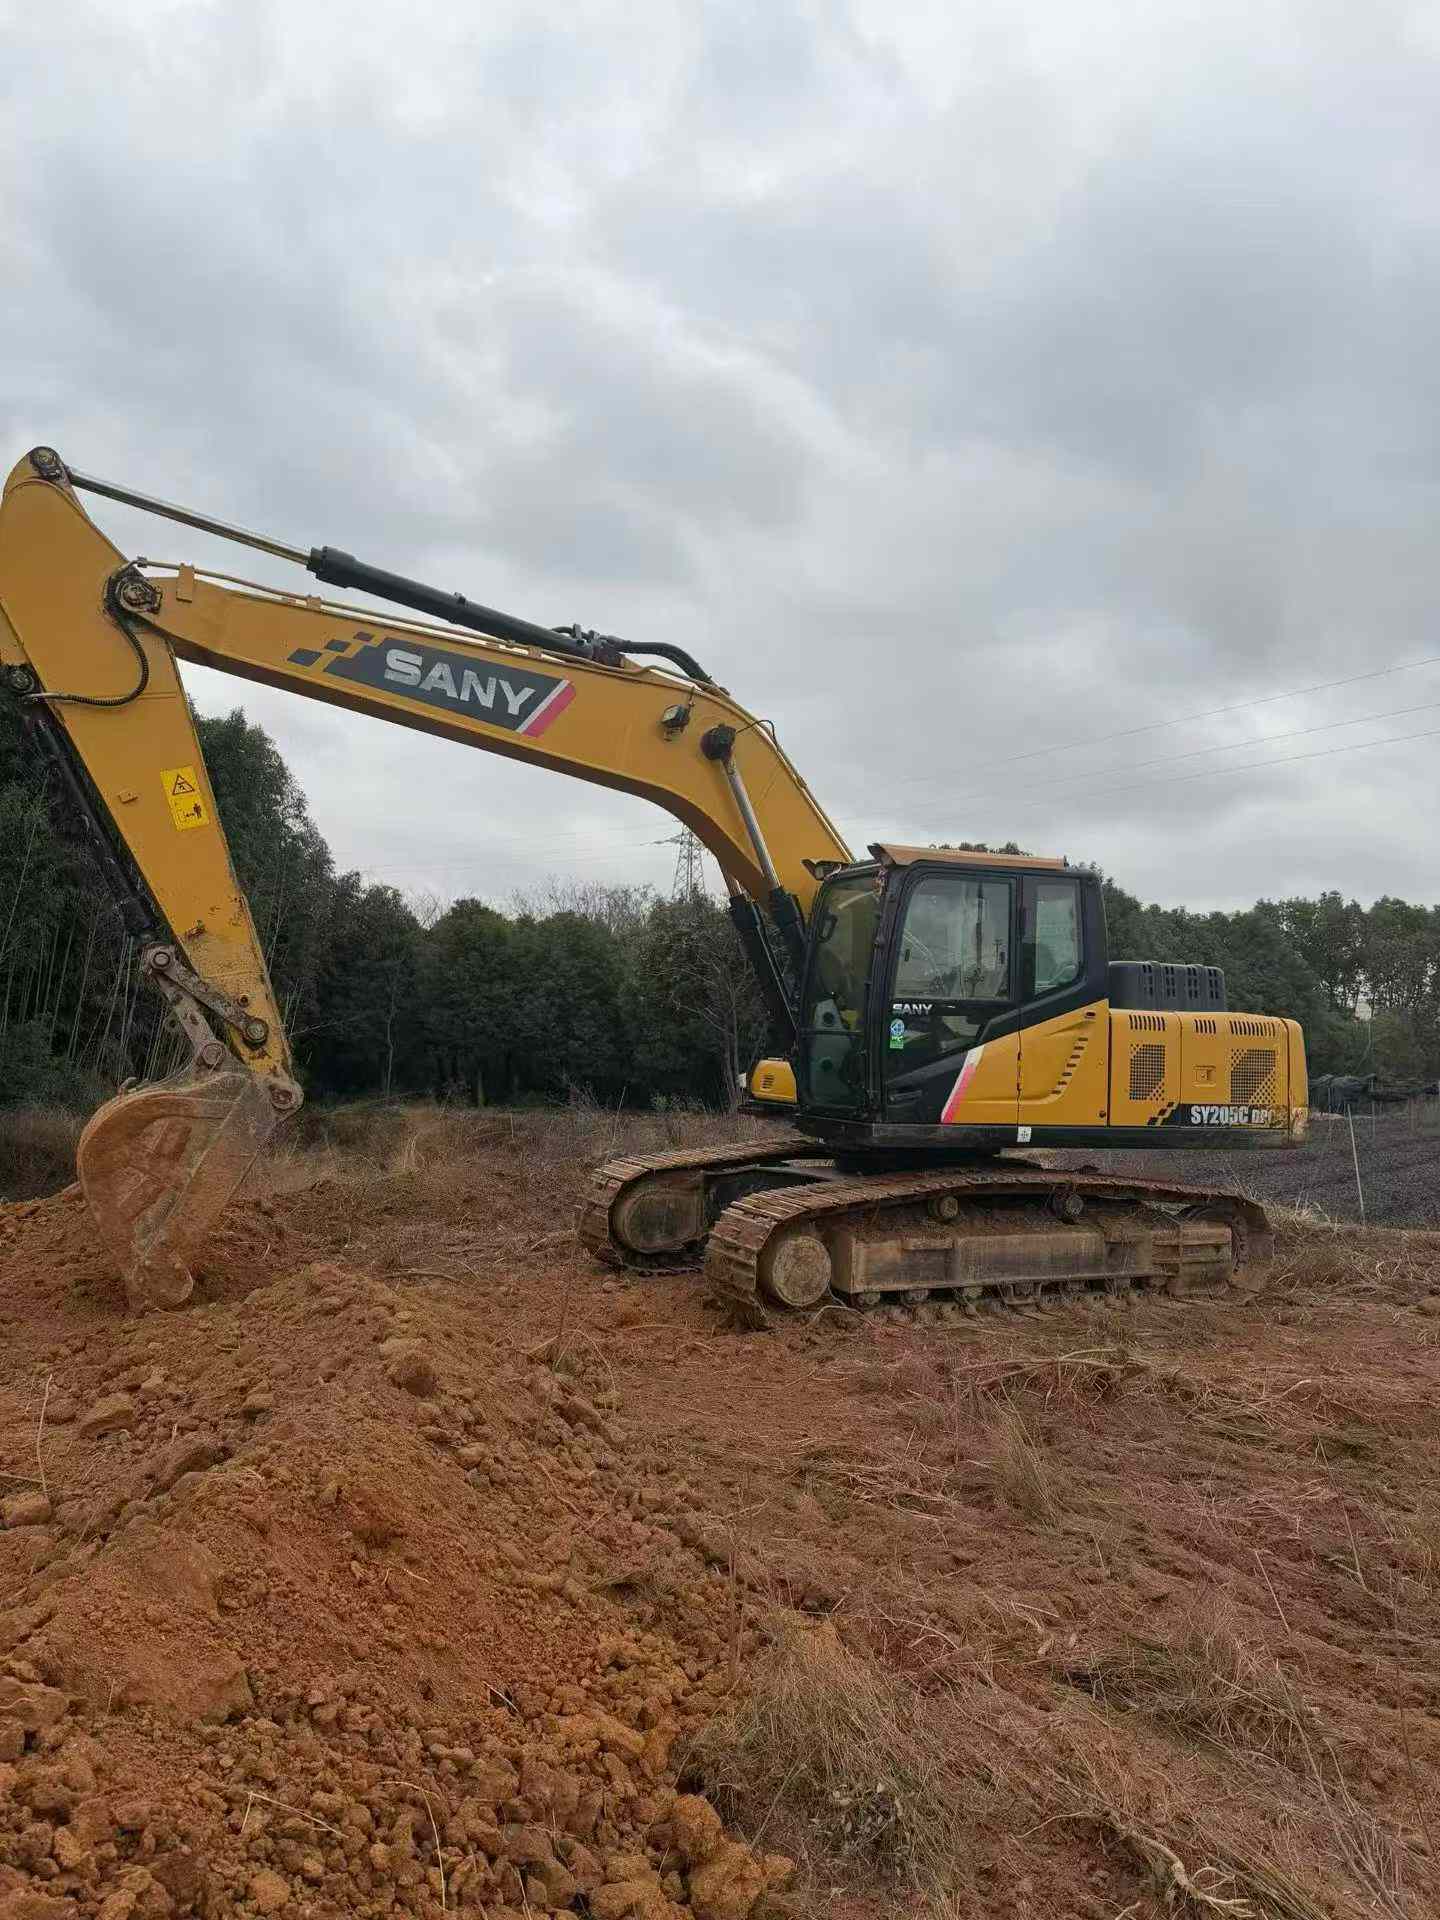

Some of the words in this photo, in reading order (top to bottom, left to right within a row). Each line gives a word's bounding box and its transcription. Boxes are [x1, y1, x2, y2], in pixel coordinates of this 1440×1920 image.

[384, 648, 534, 715] SANY
[893, 1003, 932, 1014] SANY
[1190, 1105, 1249, 1124] SY205C
